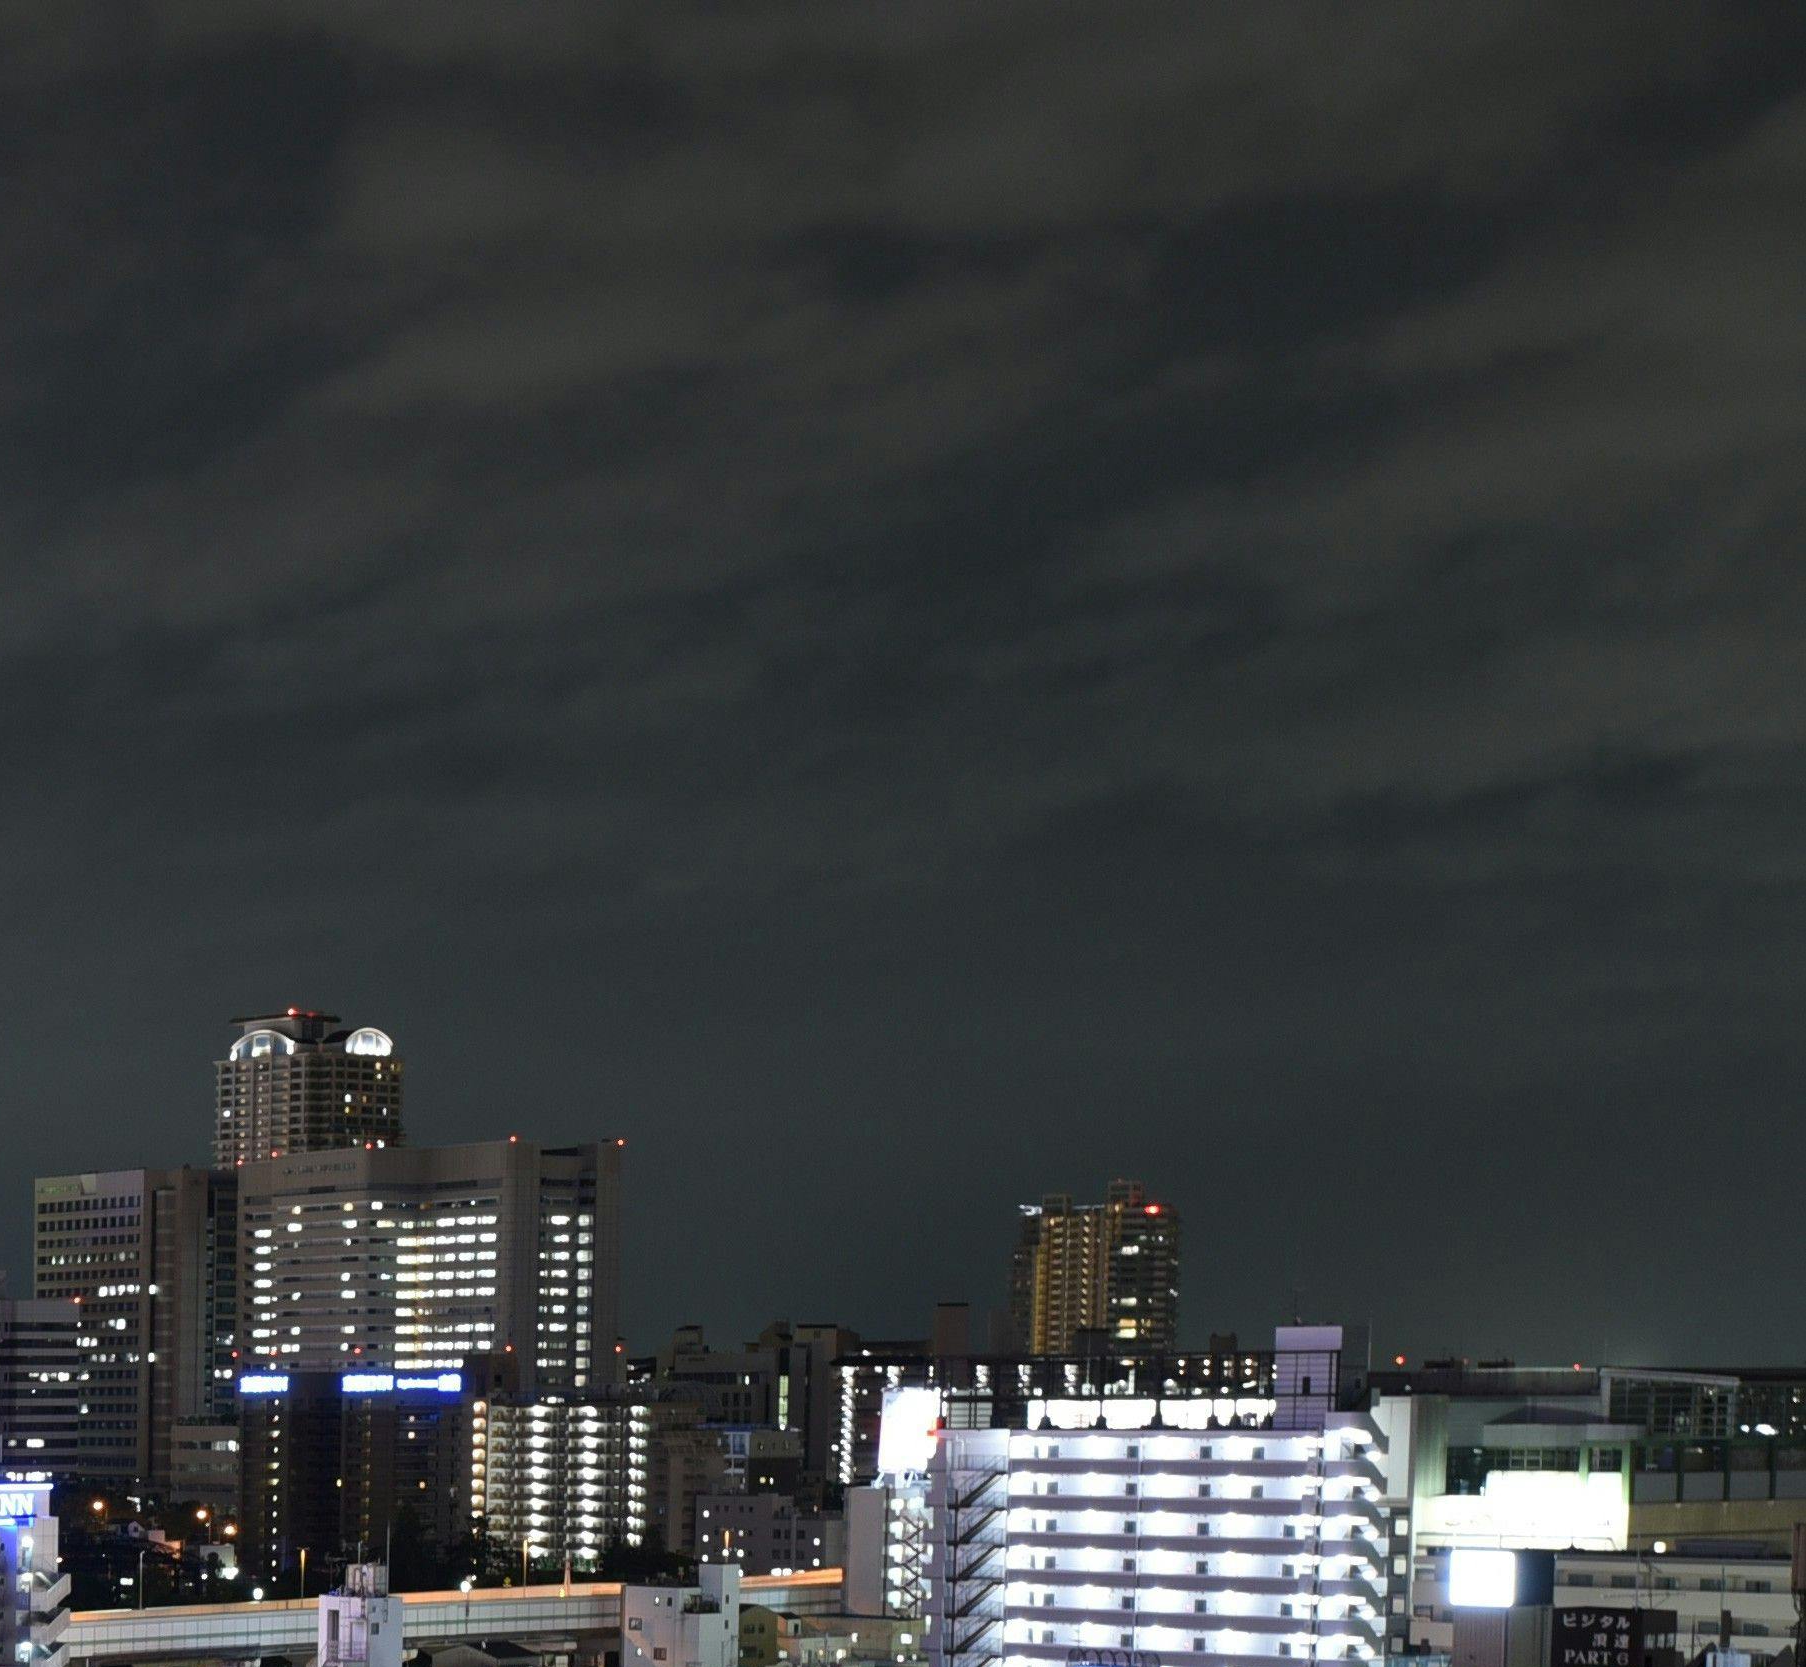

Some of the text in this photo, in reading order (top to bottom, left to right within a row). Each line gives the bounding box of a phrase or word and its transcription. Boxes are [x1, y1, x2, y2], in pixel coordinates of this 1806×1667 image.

[1562, 1613, 1630, 1629] ビジタル
[1564, 1651, 1629, 1666] PART 6
